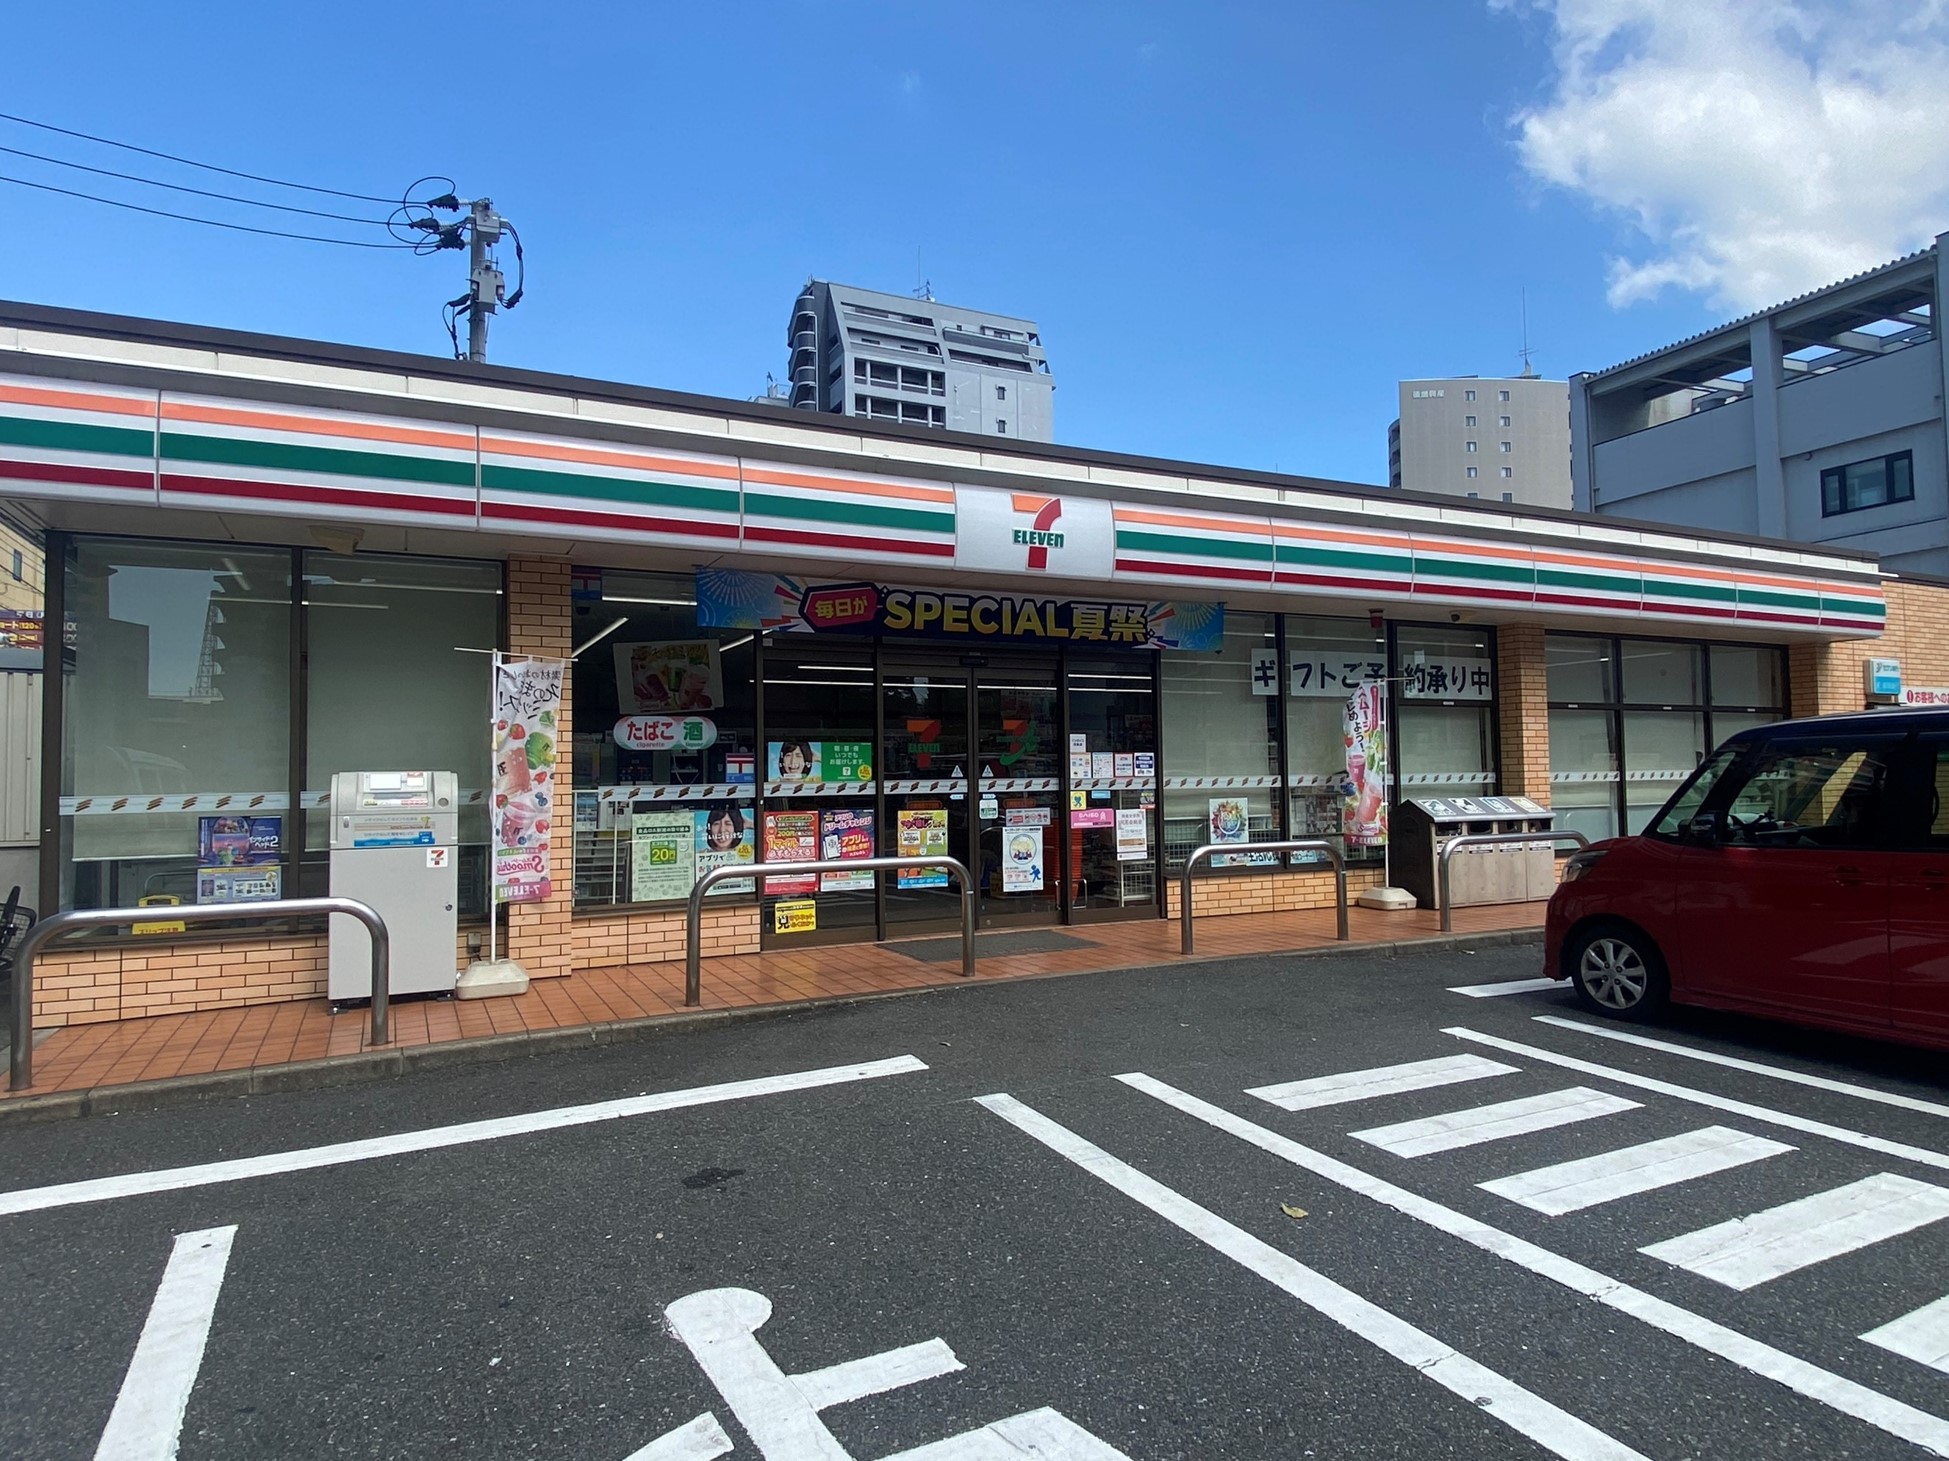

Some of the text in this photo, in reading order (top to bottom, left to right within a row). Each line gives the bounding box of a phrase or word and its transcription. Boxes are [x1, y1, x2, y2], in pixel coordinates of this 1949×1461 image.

[815, 596, 868, 619] 毎日が
[627, 721, 703, 741] たばこ 酒
